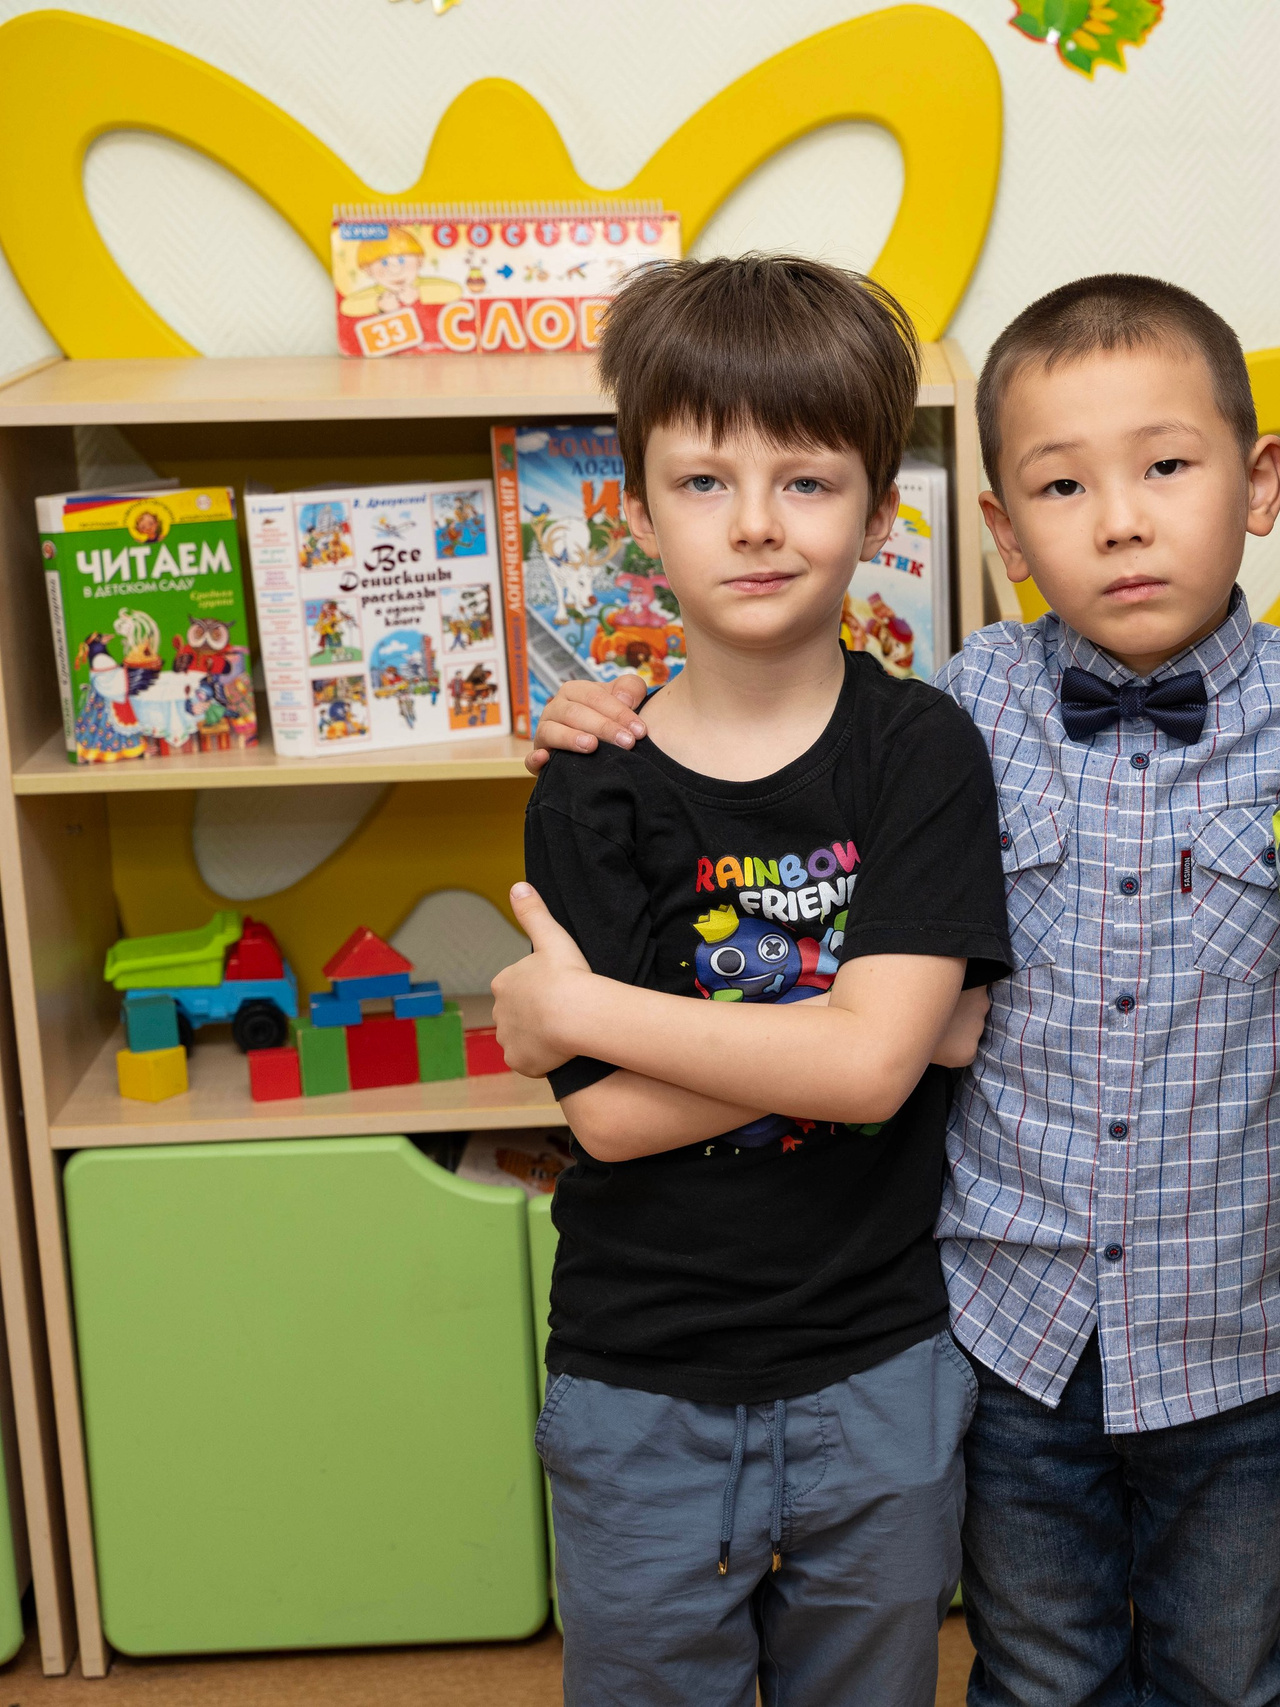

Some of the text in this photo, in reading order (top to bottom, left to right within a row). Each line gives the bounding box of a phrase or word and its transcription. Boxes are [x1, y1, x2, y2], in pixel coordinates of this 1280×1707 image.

[437, 223, 656, 246] СОСТАВЬ
[371, 319, 408, 349] 33
[500, 477, 516, 508] ИГР
[76, 540, 232, 584] ЧИТАЕМ
[364, 544, 421, 572] Все
[502, 511, 523, 613] ЛОГИЧЕСКИХ
[94, 580, 158, 599] ДЕТСКОМ
[158, 577, 195, 592] САДУ
[339, 567, 452, 592] Денискины
[361, 587, 436, 608] рассказы
[696, 841, 861, 893] RAINBOW
